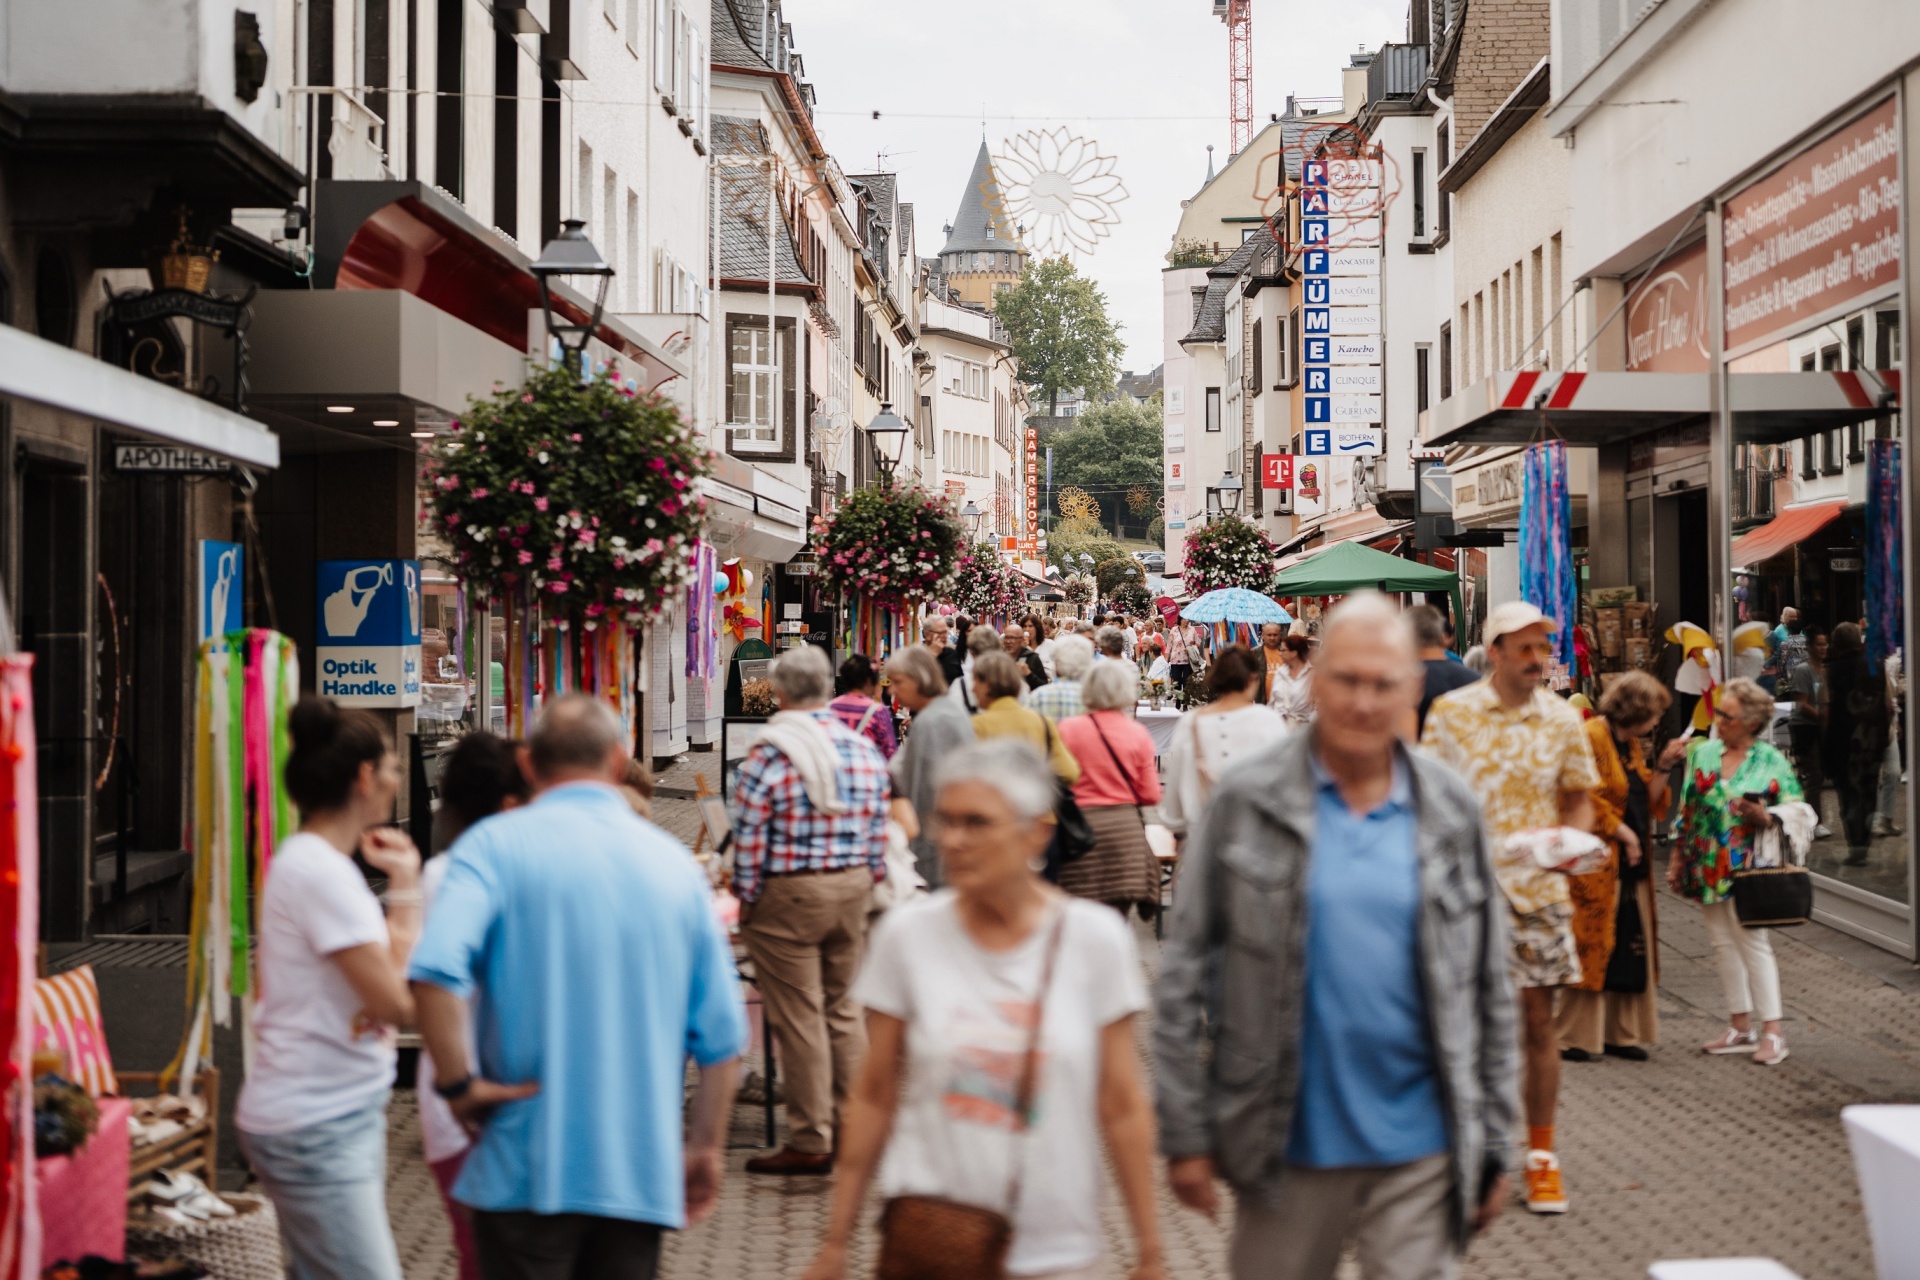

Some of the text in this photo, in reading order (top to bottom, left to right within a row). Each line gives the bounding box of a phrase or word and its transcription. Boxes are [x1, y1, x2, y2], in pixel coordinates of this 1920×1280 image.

[1334, 173, 1373, 181] CHANEL
[1334, 286, 1376, 295] LANCÔME
[1306, 164, 1328, 452] PARFÜMERIE
[1337, 345, 1374, 353] Kanebo
[1335, 377, 1377, 385] CLINIQUE
[1027, 428, 1038, 555] RAMERSHOVE
[803, 630, 828, 641] ca-Cola
[323, 659, 377, 678] Optik
[323, 680, 397, 695] Handke
